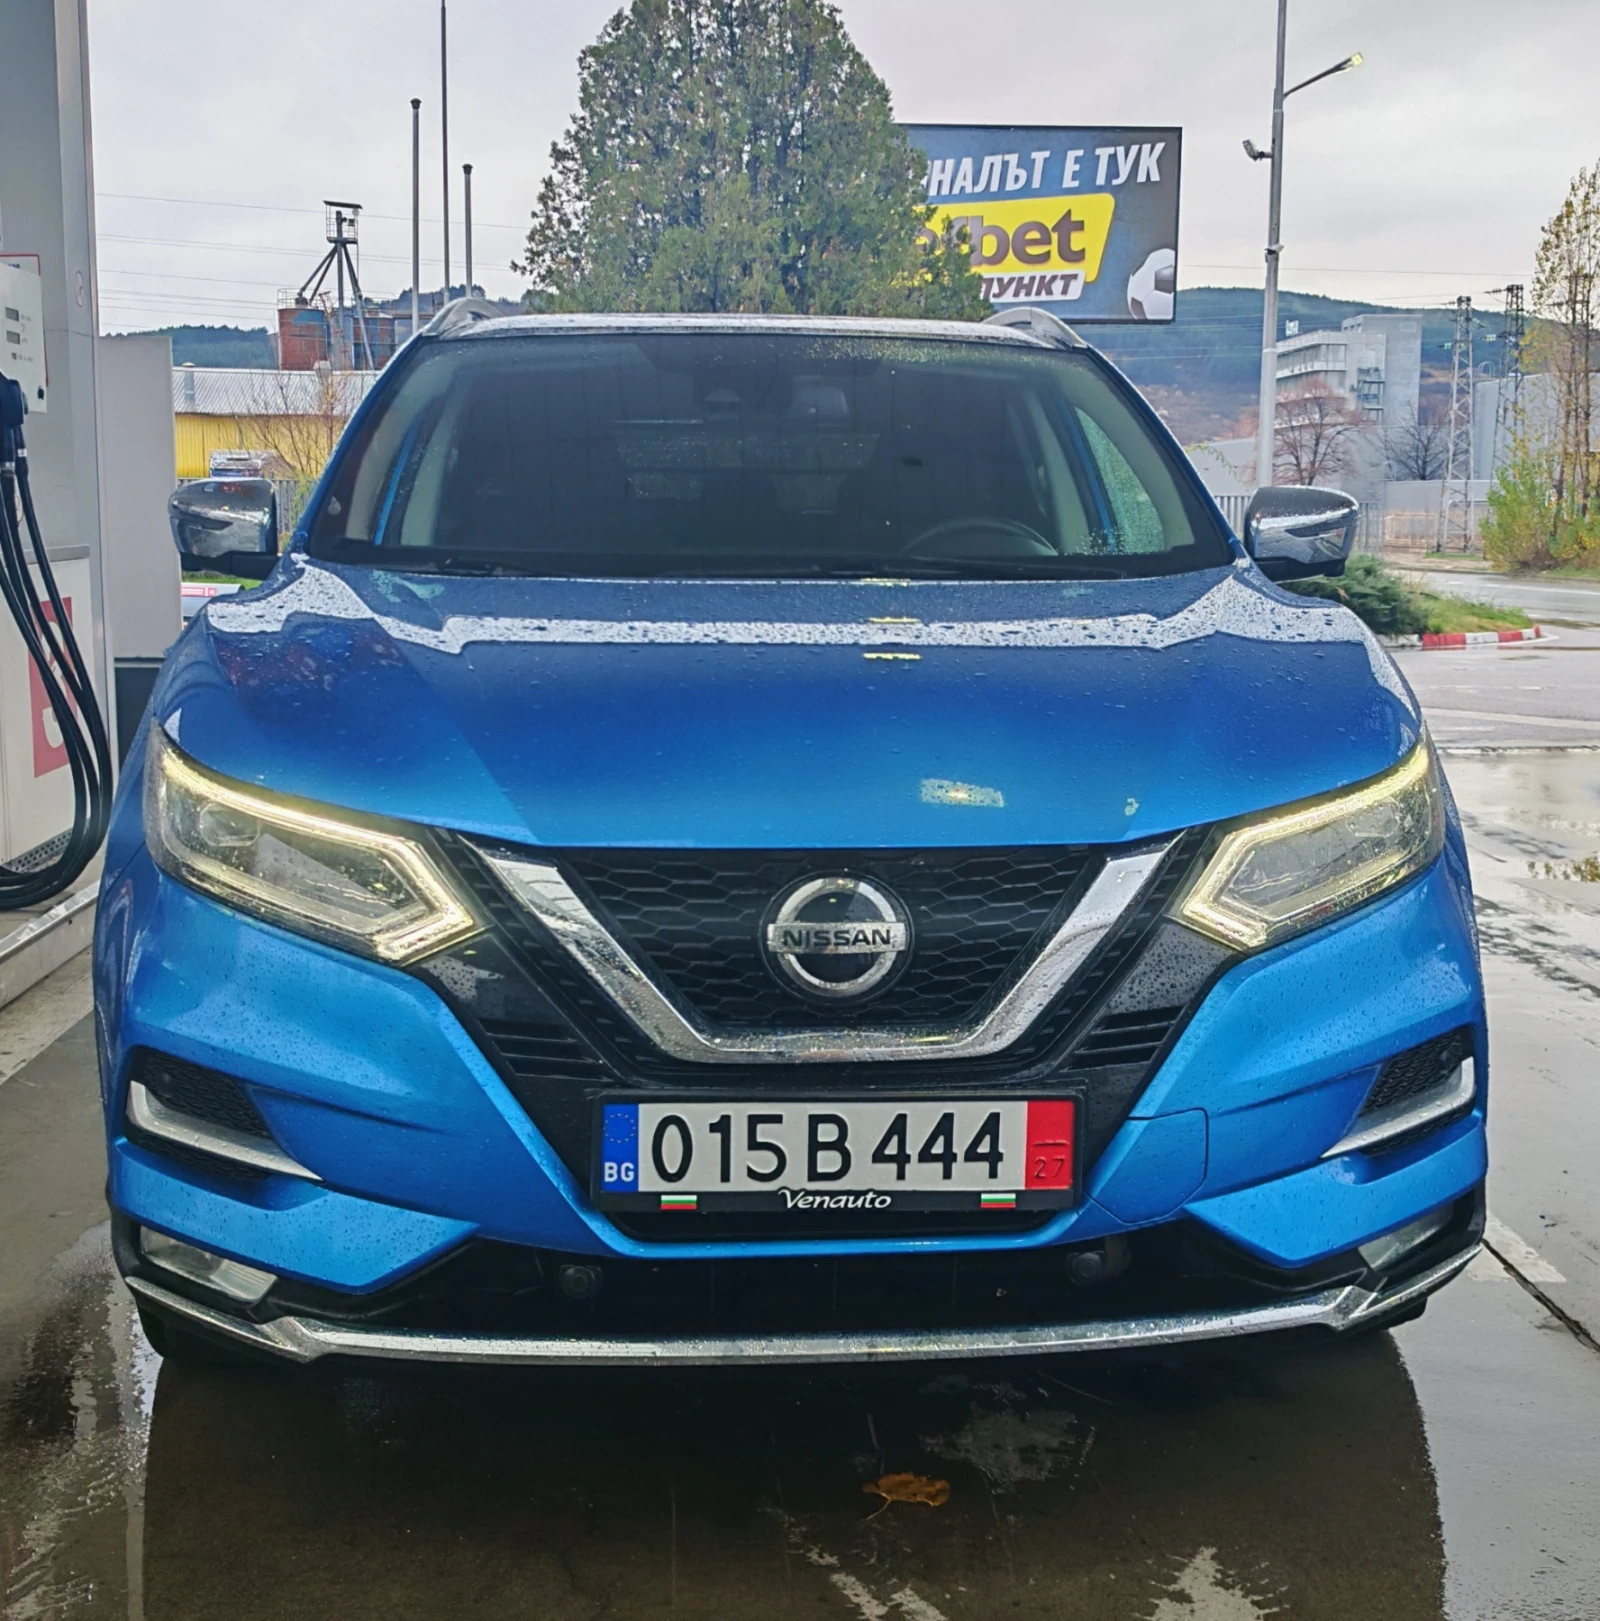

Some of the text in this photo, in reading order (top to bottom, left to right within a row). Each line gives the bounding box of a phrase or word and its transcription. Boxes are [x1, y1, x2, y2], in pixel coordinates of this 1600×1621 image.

[921, 142, 1165, 196] НАЛЪТ Е ТУК
[782, 929, 891, 947] NISSAN
[604, 1162, 635, 1182] BG
[1034, 1156, 1066, 1179] 27
[778, 1189, 892, 1209] Venauto
